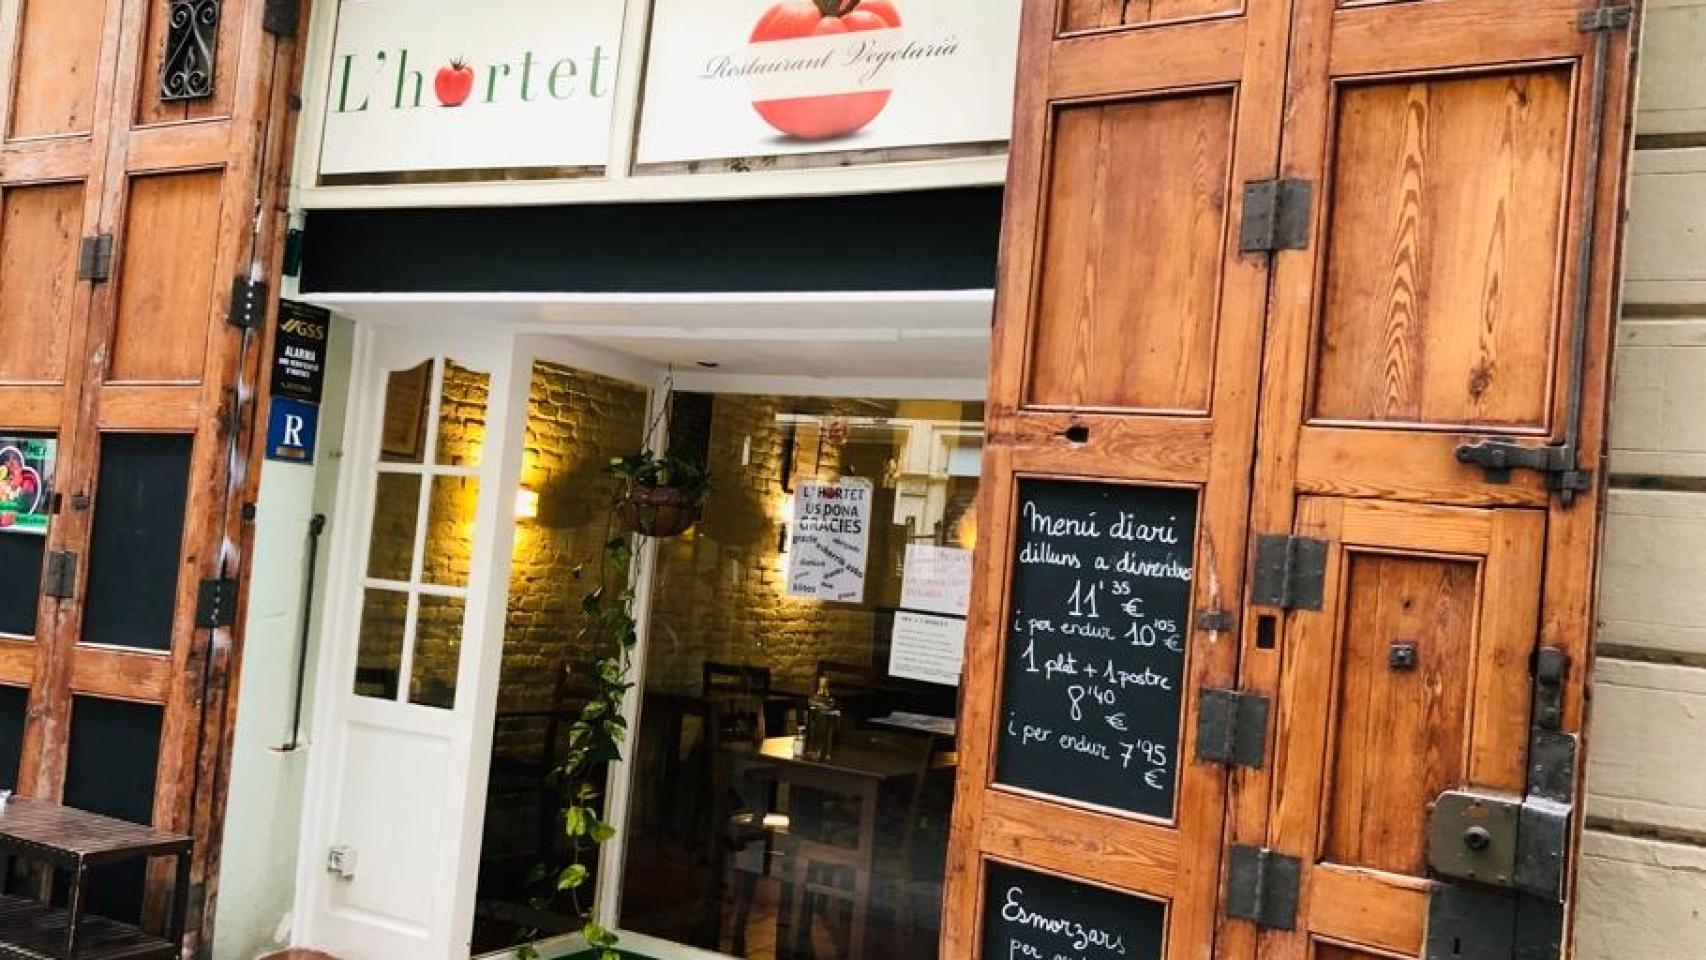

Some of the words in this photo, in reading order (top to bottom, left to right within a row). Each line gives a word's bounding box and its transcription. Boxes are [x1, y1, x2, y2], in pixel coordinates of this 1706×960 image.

[698, 49, 834, 79] Restaurant
[285, 345, 316, 361] ALARMA
[282, 413, 304, 447] R
[805, 503, 822, 515] US
[824, 503, 859, 518] DONA
[1023, 500, 1101, 537] Menú
[1109, 511, 1178, 544] diari
[1019, 542, 1081, 569] dilluns
[1094, 556, 1109, 571] a
[1120, 597, 1145, 618] €
[1014, 608, 1022, 632] i
[1060, 622, 1116, 640] endur
[1021, 638, 1040, 672] 1
[1044, 652, 1078, 680] plat
[1083, 663, 1098, 678] +
[1103, 659, 1118, 684] 1
[1117, 666, 1172, 691] postre
[1104, 712, 1128, 731] €
[1007, 711, 1017, 736] i
[1022, 725, 1052, 745] per
[1059, 734, 1111, 760] endur
[1144, 768, 1167, 790] €
[1002, 886, 1126, 955] Esmorzars
[1009, 938, 1043, 960] per
